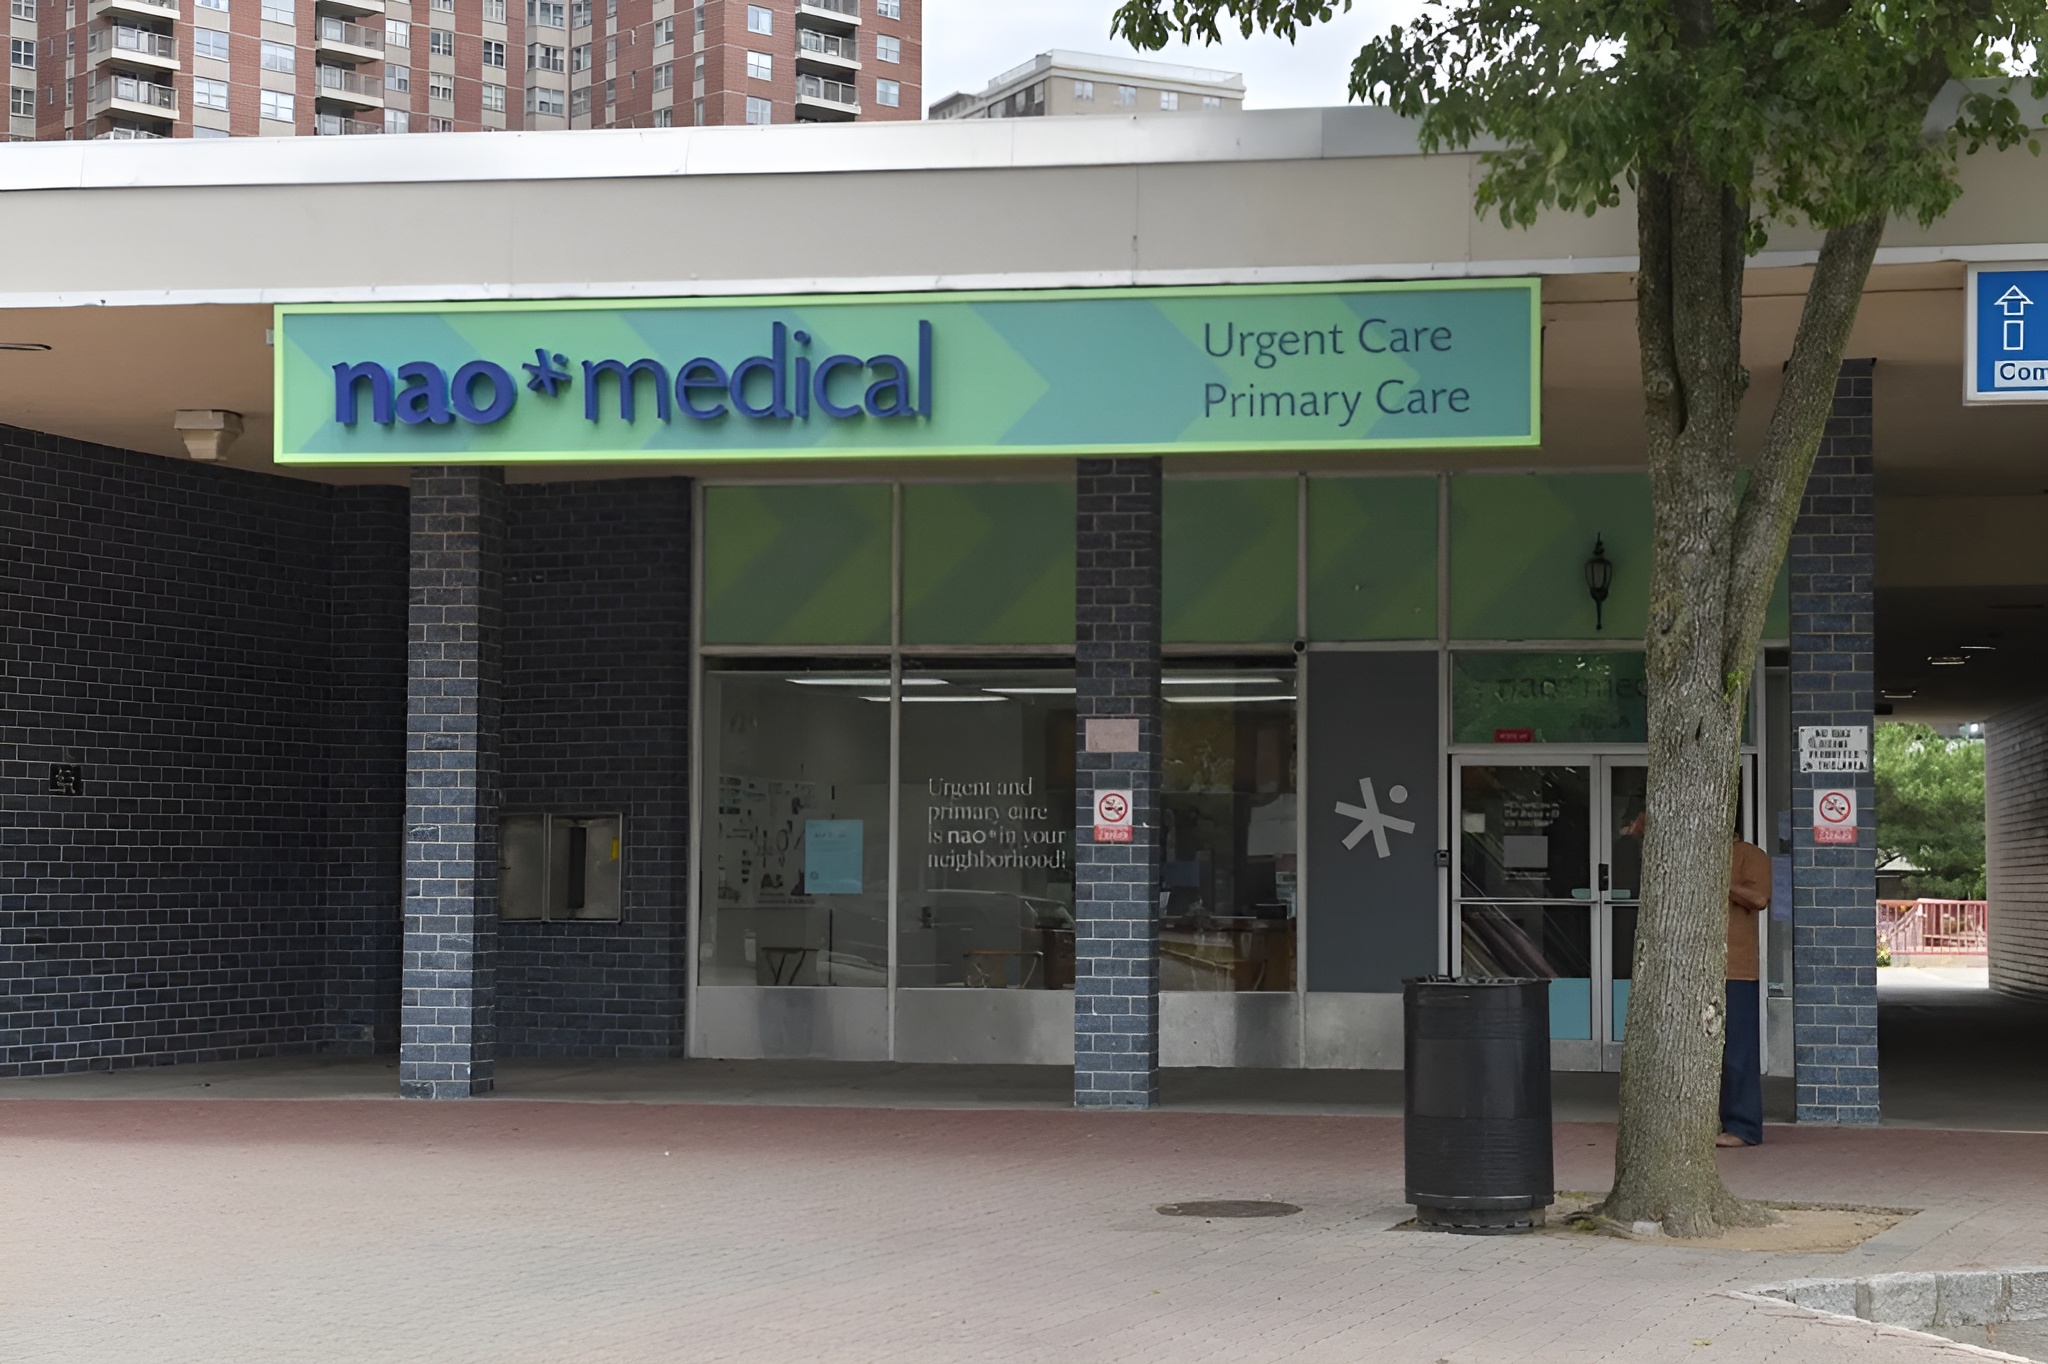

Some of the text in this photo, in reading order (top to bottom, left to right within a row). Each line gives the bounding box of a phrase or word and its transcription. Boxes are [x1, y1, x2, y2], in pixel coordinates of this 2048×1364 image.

[1204, 318, 1453, 369] Urgent Care
[332, 319, 932, 425] nao medical
[1204, 379, 1470, 427] Primary Care
[929, 776, 1033, 799] Urgent and
[928, 801, 1048, 825] primary care
[999, 825, 1016, 843] in
[1022, 829, 1066, 849] your
